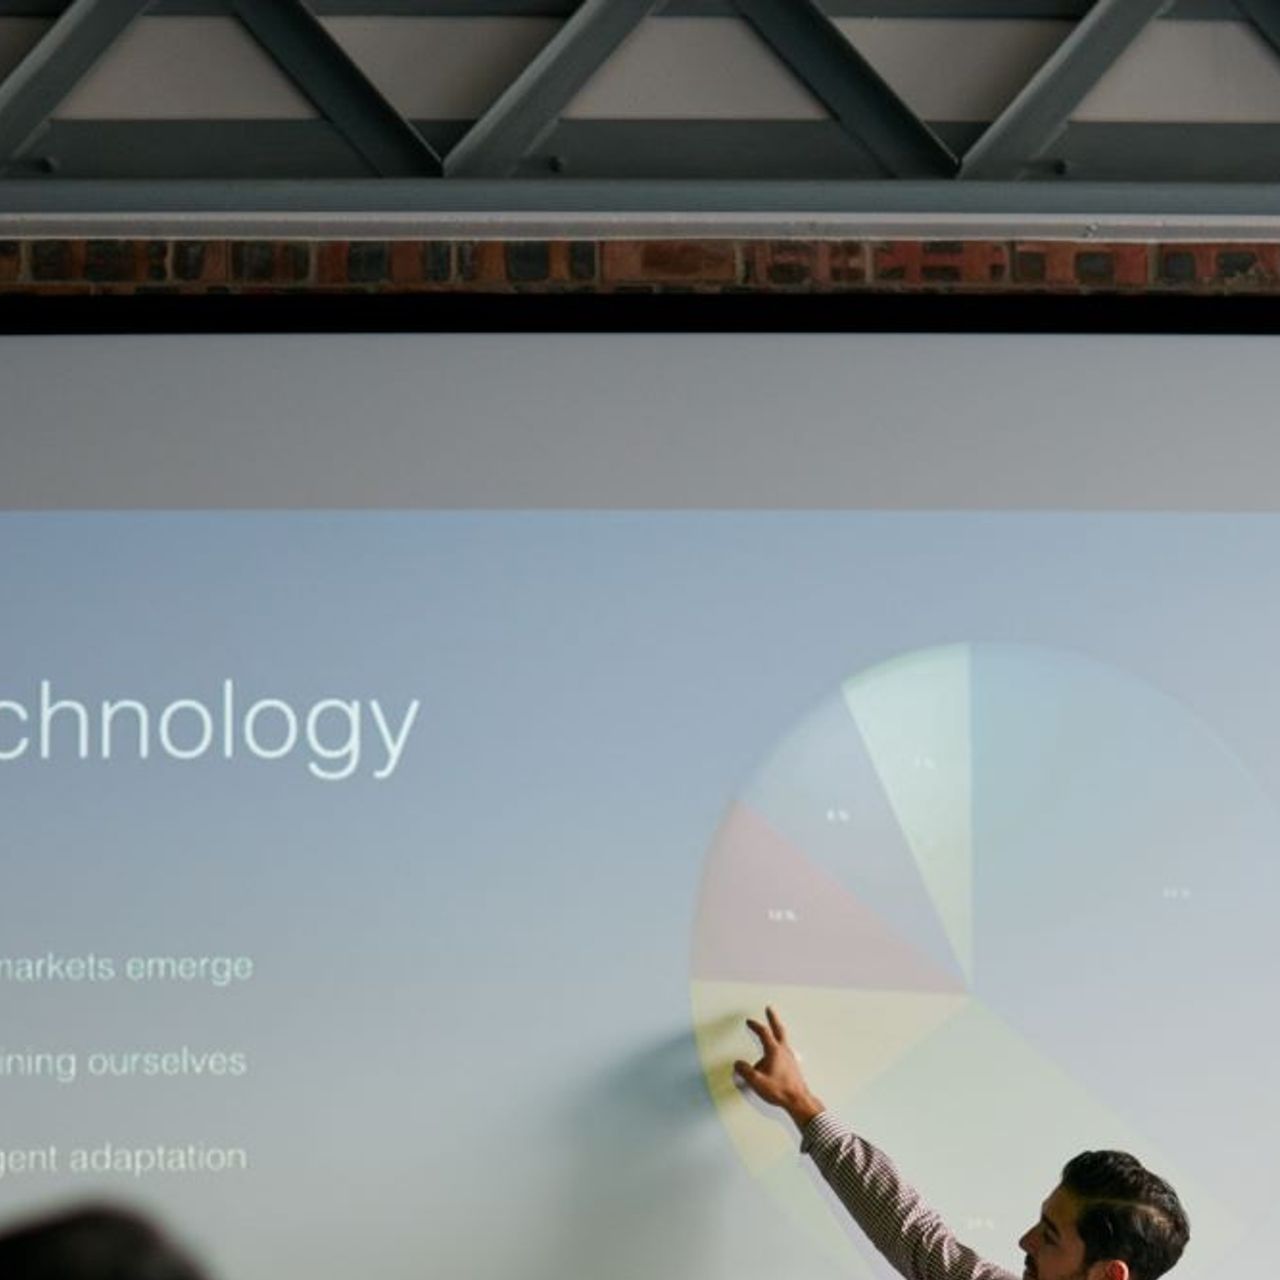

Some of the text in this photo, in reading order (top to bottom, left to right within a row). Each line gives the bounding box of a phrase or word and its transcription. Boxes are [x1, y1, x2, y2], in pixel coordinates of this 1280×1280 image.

[125, 956, 254, 988] emerge
[87, 1045, 248, 1077] ourselves
[68, 1140, 248, 1179] adaptation
